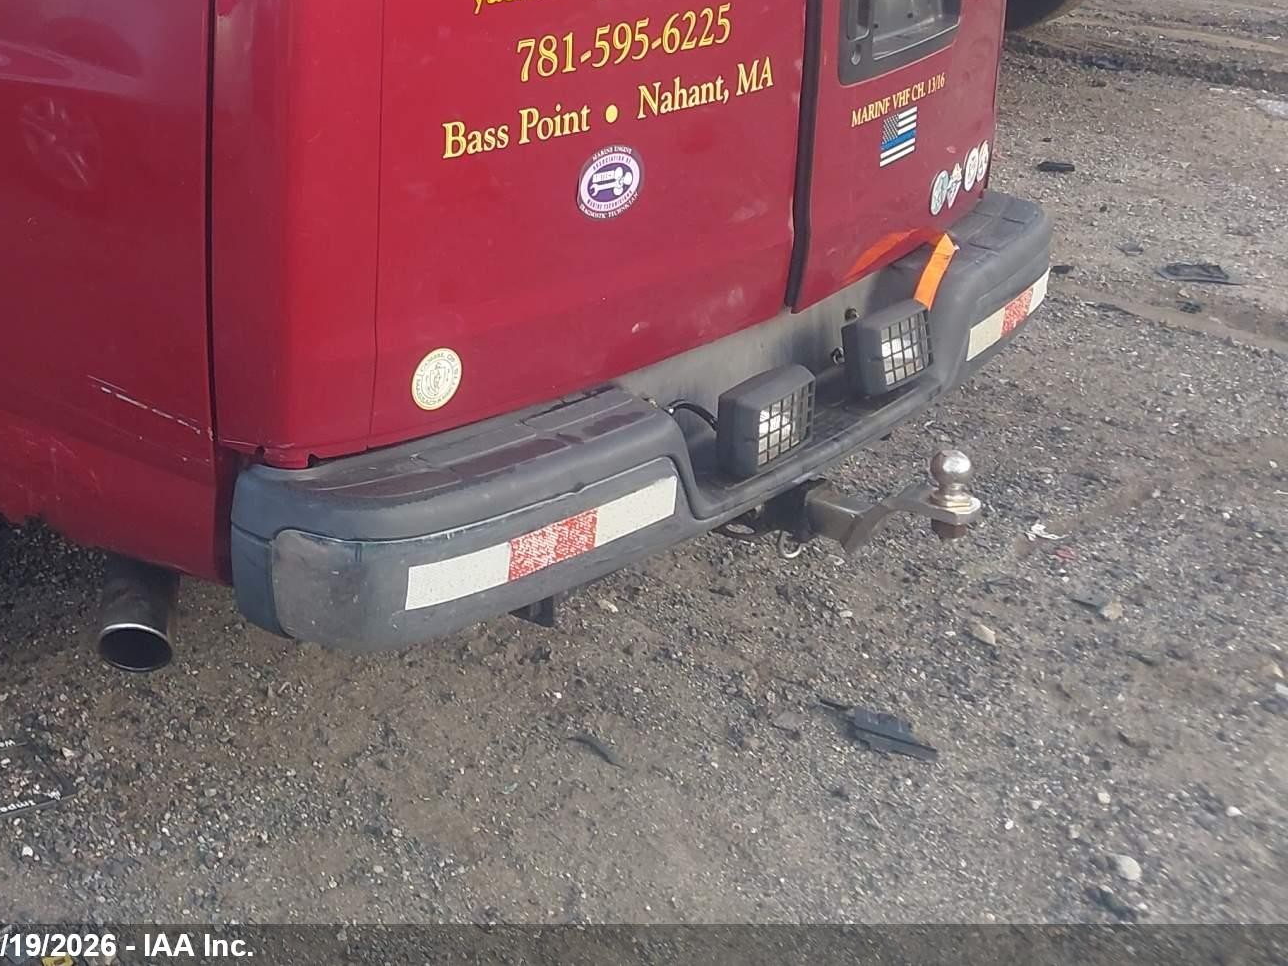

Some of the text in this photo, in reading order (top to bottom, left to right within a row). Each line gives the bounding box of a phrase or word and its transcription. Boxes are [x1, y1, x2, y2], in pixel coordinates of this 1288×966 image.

[516, 2, 732, 82] 781-595-6225
[442, 56, 775, 159] Bass Point Nahant, MA
[892, 88, 911, 110] VHF
[912, 81, 926, 102] CH.
[928, 72, 946, 95] 13/16
